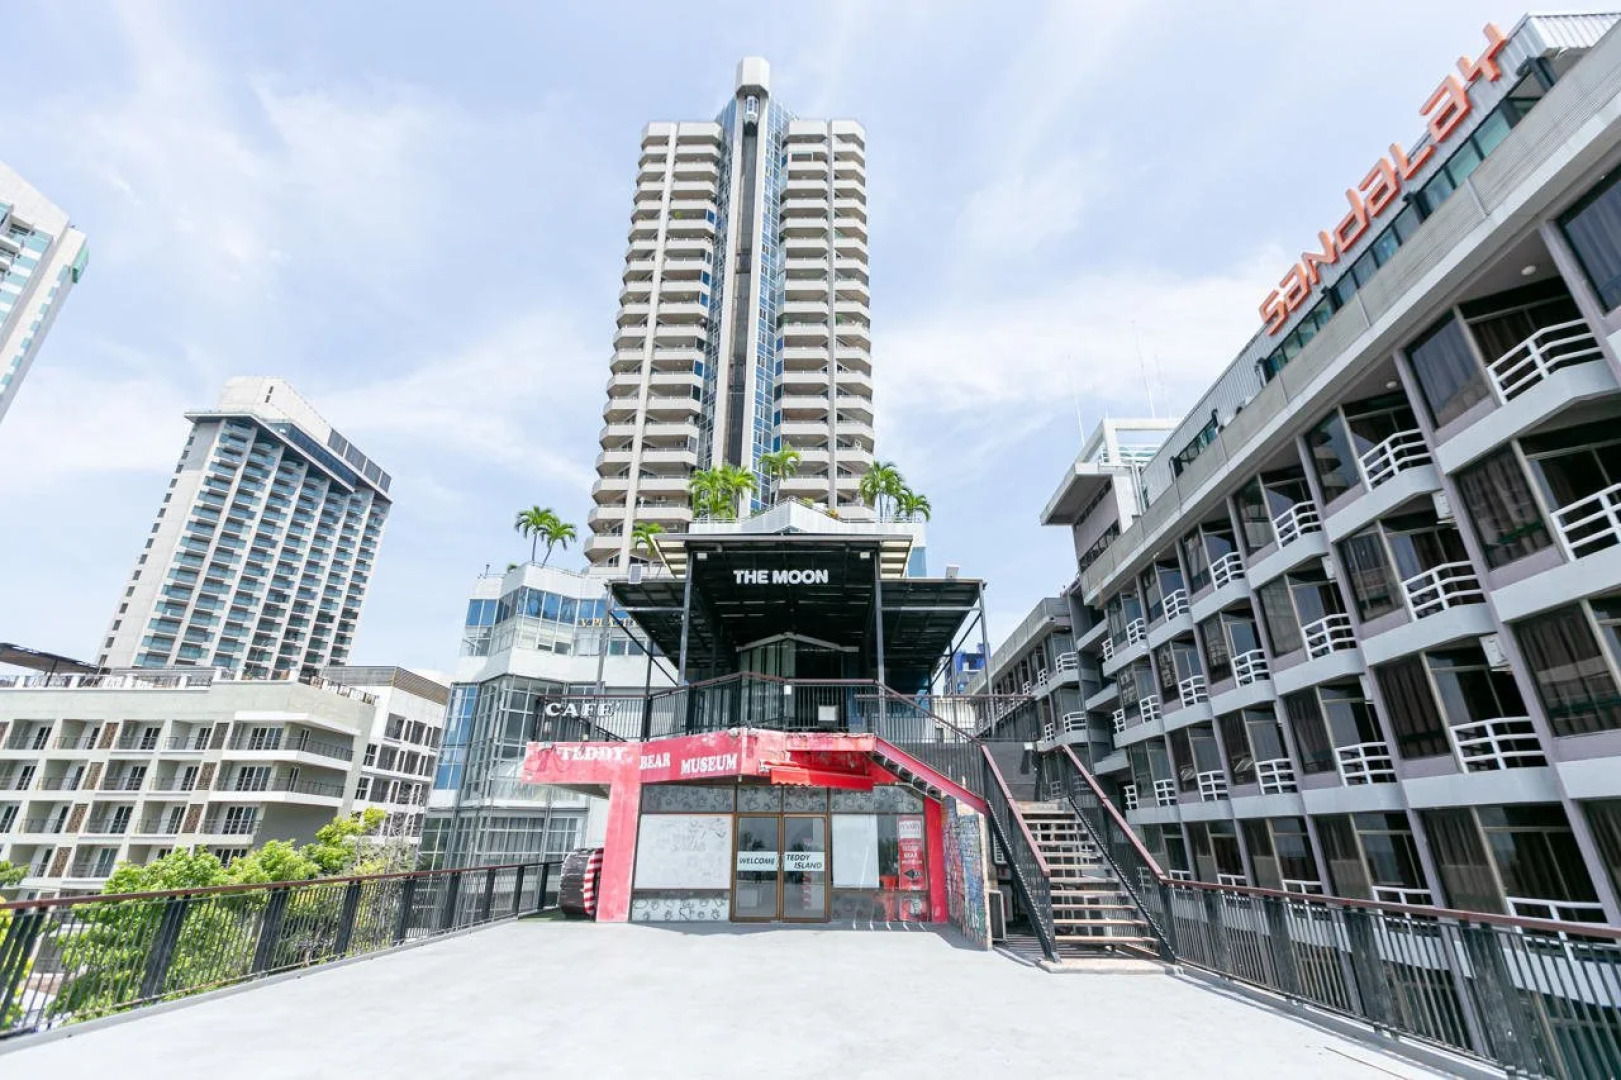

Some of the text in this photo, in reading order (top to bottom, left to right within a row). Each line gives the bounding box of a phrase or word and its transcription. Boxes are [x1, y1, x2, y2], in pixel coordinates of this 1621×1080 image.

[733, 569, 829, 584] THE MOON
[560, 746, 628, 761] TEDDY
[640, 752, 671, 770] BEAR
[680, 753, 738, 775] MUSEUM
[739, 857, 776, 866] WELCOME
[786, 854, 811, 862] TEDDY
